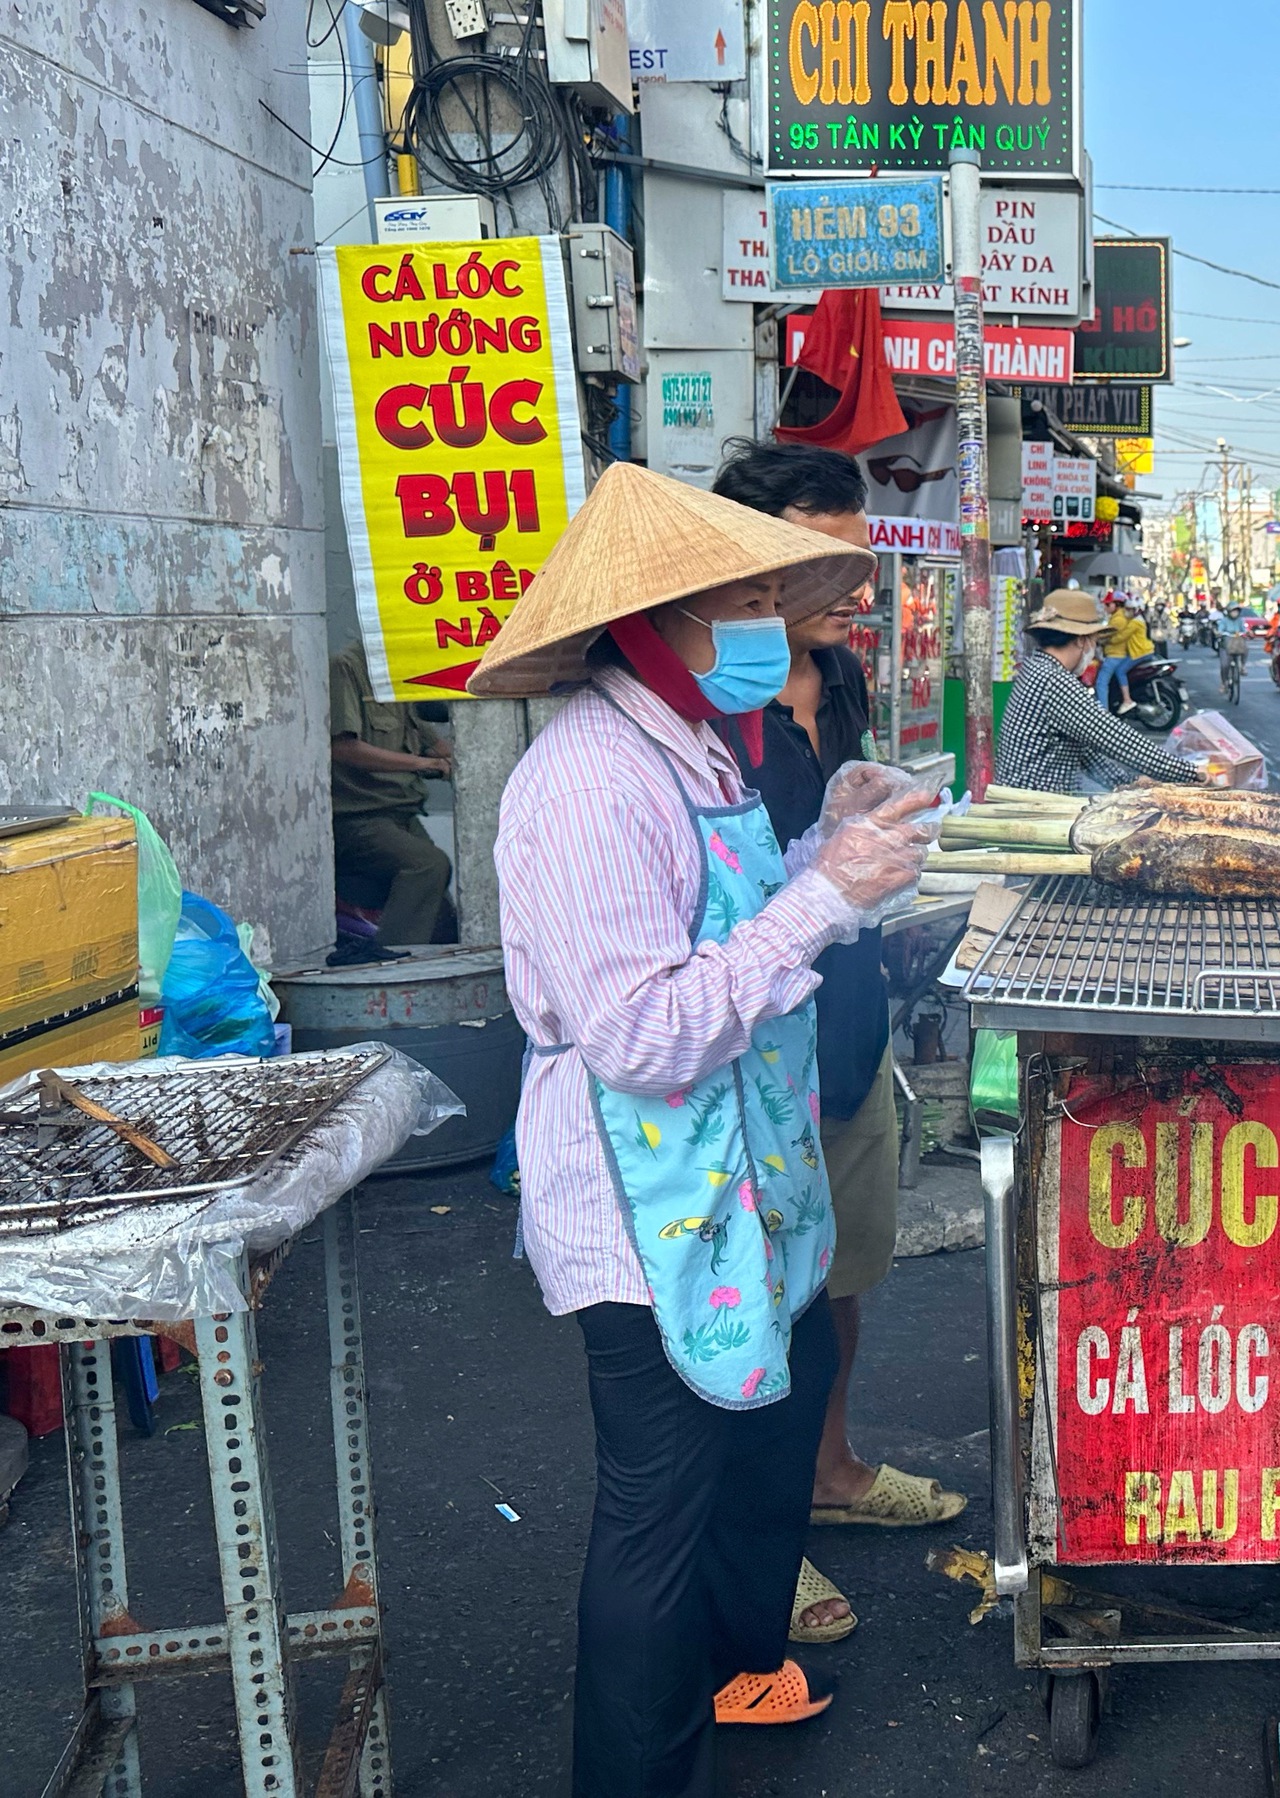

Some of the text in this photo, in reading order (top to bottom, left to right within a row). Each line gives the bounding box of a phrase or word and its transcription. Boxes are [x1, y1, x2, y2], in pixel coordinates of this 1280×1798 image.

[789, 114, 1051, 152] 95 TÂN KỲ TÂN QUÝ
[791, 195, 867, 241] HẺM
[878, 203, 920, 238] 93
[995, 200, 1036, 219] PIN
[987, 220, 1035, 245] DẦU
[361, 251, 524, 302] CÁ LÓC
[893, 248, 928, 271] 8M
[1022, 255, 1055, 274] DA
[1010, 281, 1070, 306] KÍNH
[368, 308, 544, 359] NƯỚNG
[983, 337, 1065, 379] THÀNH
[374, 365, 549, 450] CÚC
[395, 468, 541, 551] BỤI
[404, 561, 444, 605] Ở
[436, 607, 504, 650] NÀ
[1088, 1095, 1280, 1249] CÚC
[1076, 1305, 1150, 1416] CÁ
[1168, 1304, 1270, 1414] LÓC
[1124, 1467, 1240, 1546] RAU
